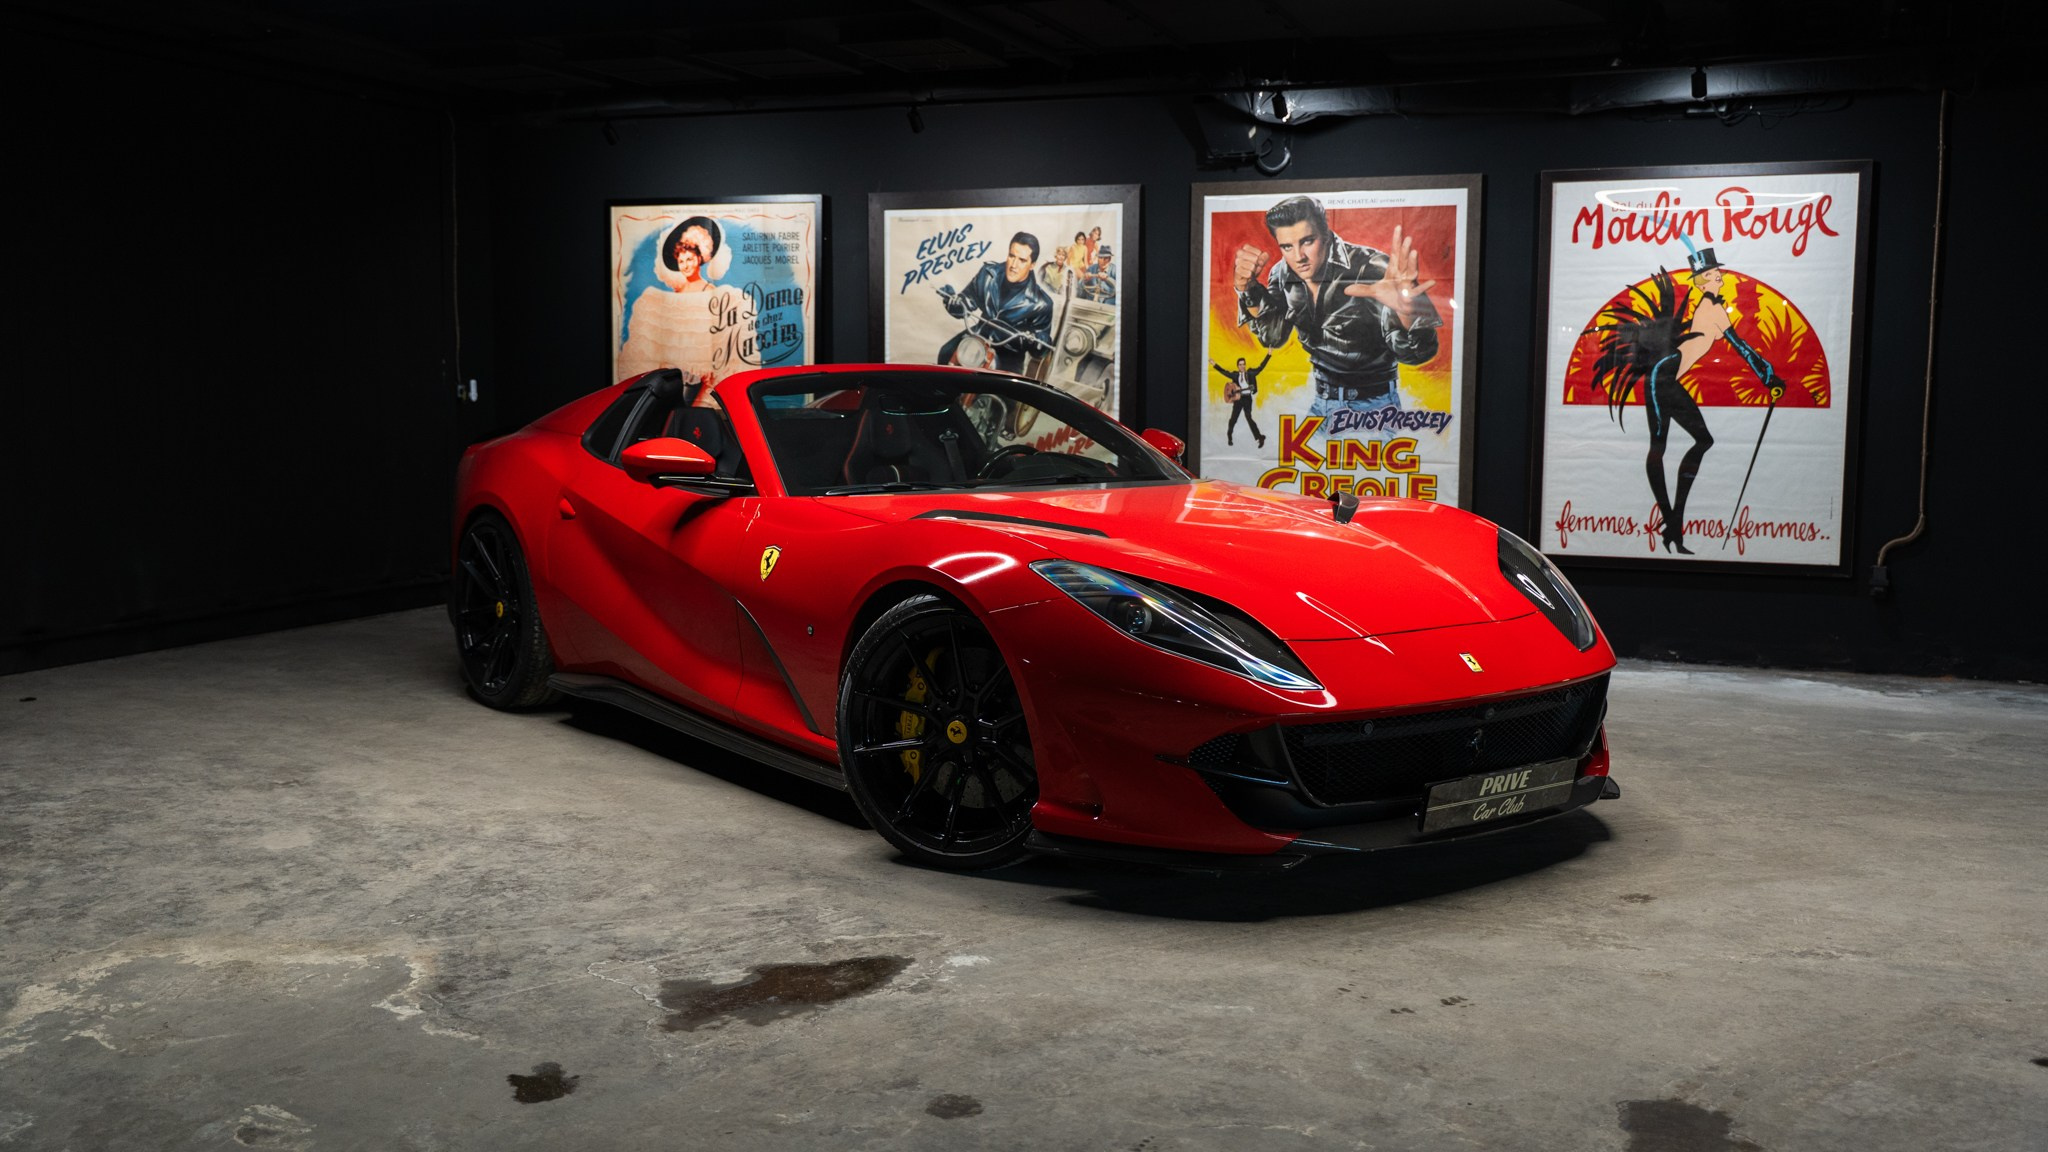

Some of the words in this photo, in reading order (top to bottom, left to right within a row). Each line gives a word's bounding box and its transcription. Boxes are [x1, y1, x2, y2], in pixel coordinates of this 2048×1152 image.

[742, 232, 776, 242] SATURNIN
[778, 231, 800, 241] FABRE
[1571, 191, 1714, 250] Moulin
[1715, 186, 1840, 257] Rouge
[742, 243, 770, 252] ARLETTE
[772, 243, 800, 252] POIRIER
[916, 223, 973, 260] ELVIS
[742, 255, 772, 265] JACQUES
[774, 255, 800, 264] MOREL
[901, 240, 992, 295] PRESLEY
[709, 292, 737, 335] La
[742, 281, 804, 320] Dame
[748, 320, 760, 331] de
[762, 312, 783, 326] chez
[712, 322, 804, 370] Maxim
[1330, 409, 1381, 435] ELVIS
[1377, 406, 1453, 435] PRESLEY
[1278, 414, 1421, 474] KING
[1555, 500, 1641, 549] femmes,
[1479, 769, 1533, 796] PRIVE
[1473, 802, 1496, 822] Car
[1497, 794, 1527, 817] Club
